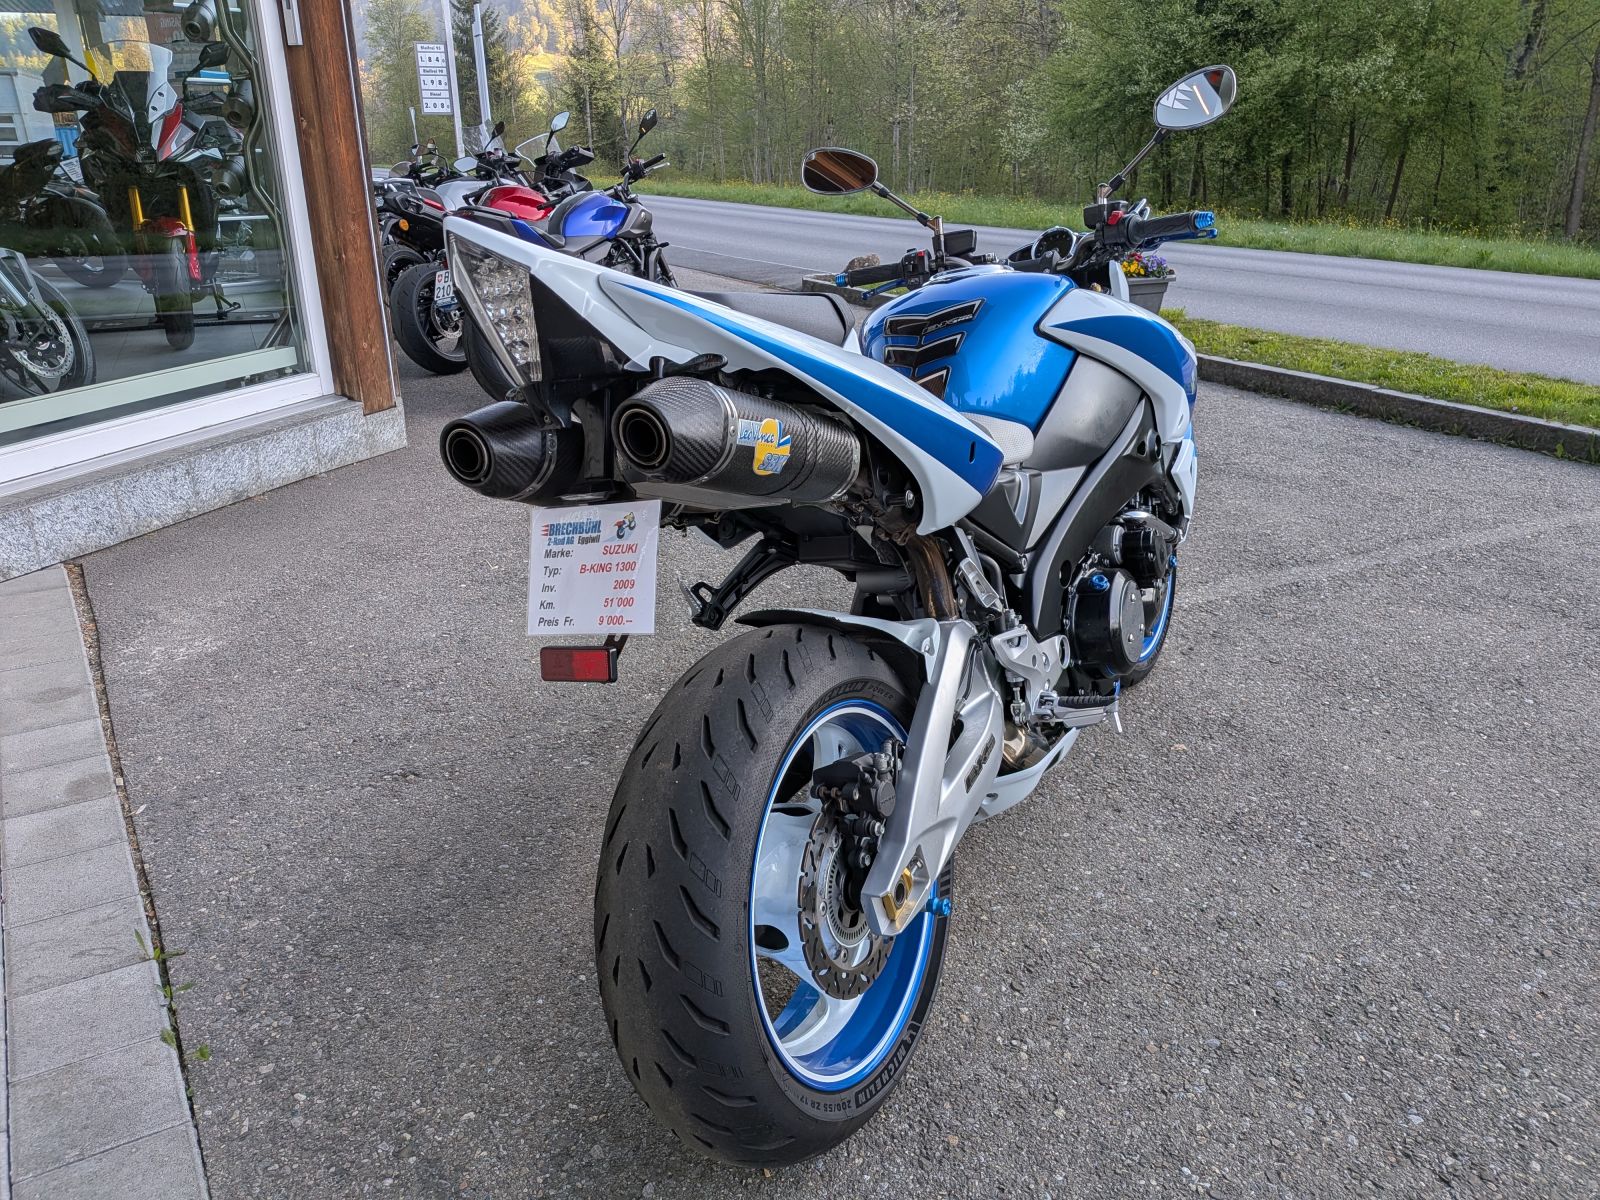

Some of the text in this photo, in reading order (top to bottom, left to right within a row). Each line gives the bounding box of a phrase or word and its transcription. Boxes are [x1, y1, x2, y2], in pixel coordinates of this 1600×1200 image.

[548, 518, 602, 536] BRECHBÜHL
[566, 536, 575, 545] AG
[543, 543, 638, 559] Marke: SUZUKI
[543, 561, 637, 577] Typ: B-KING 1300
[541, 579, 635, 593] Inv. 2009
[539, 600, 556, 610] Km.
[537, 617, 559, 627] Preis
[563, 616, 575, 626] Fr.
[857, 1046, 908, 1104] MICHELIN
[810, 1101, 821, 1111] ZR
[823, 1098, 851, 1113] 200/55
